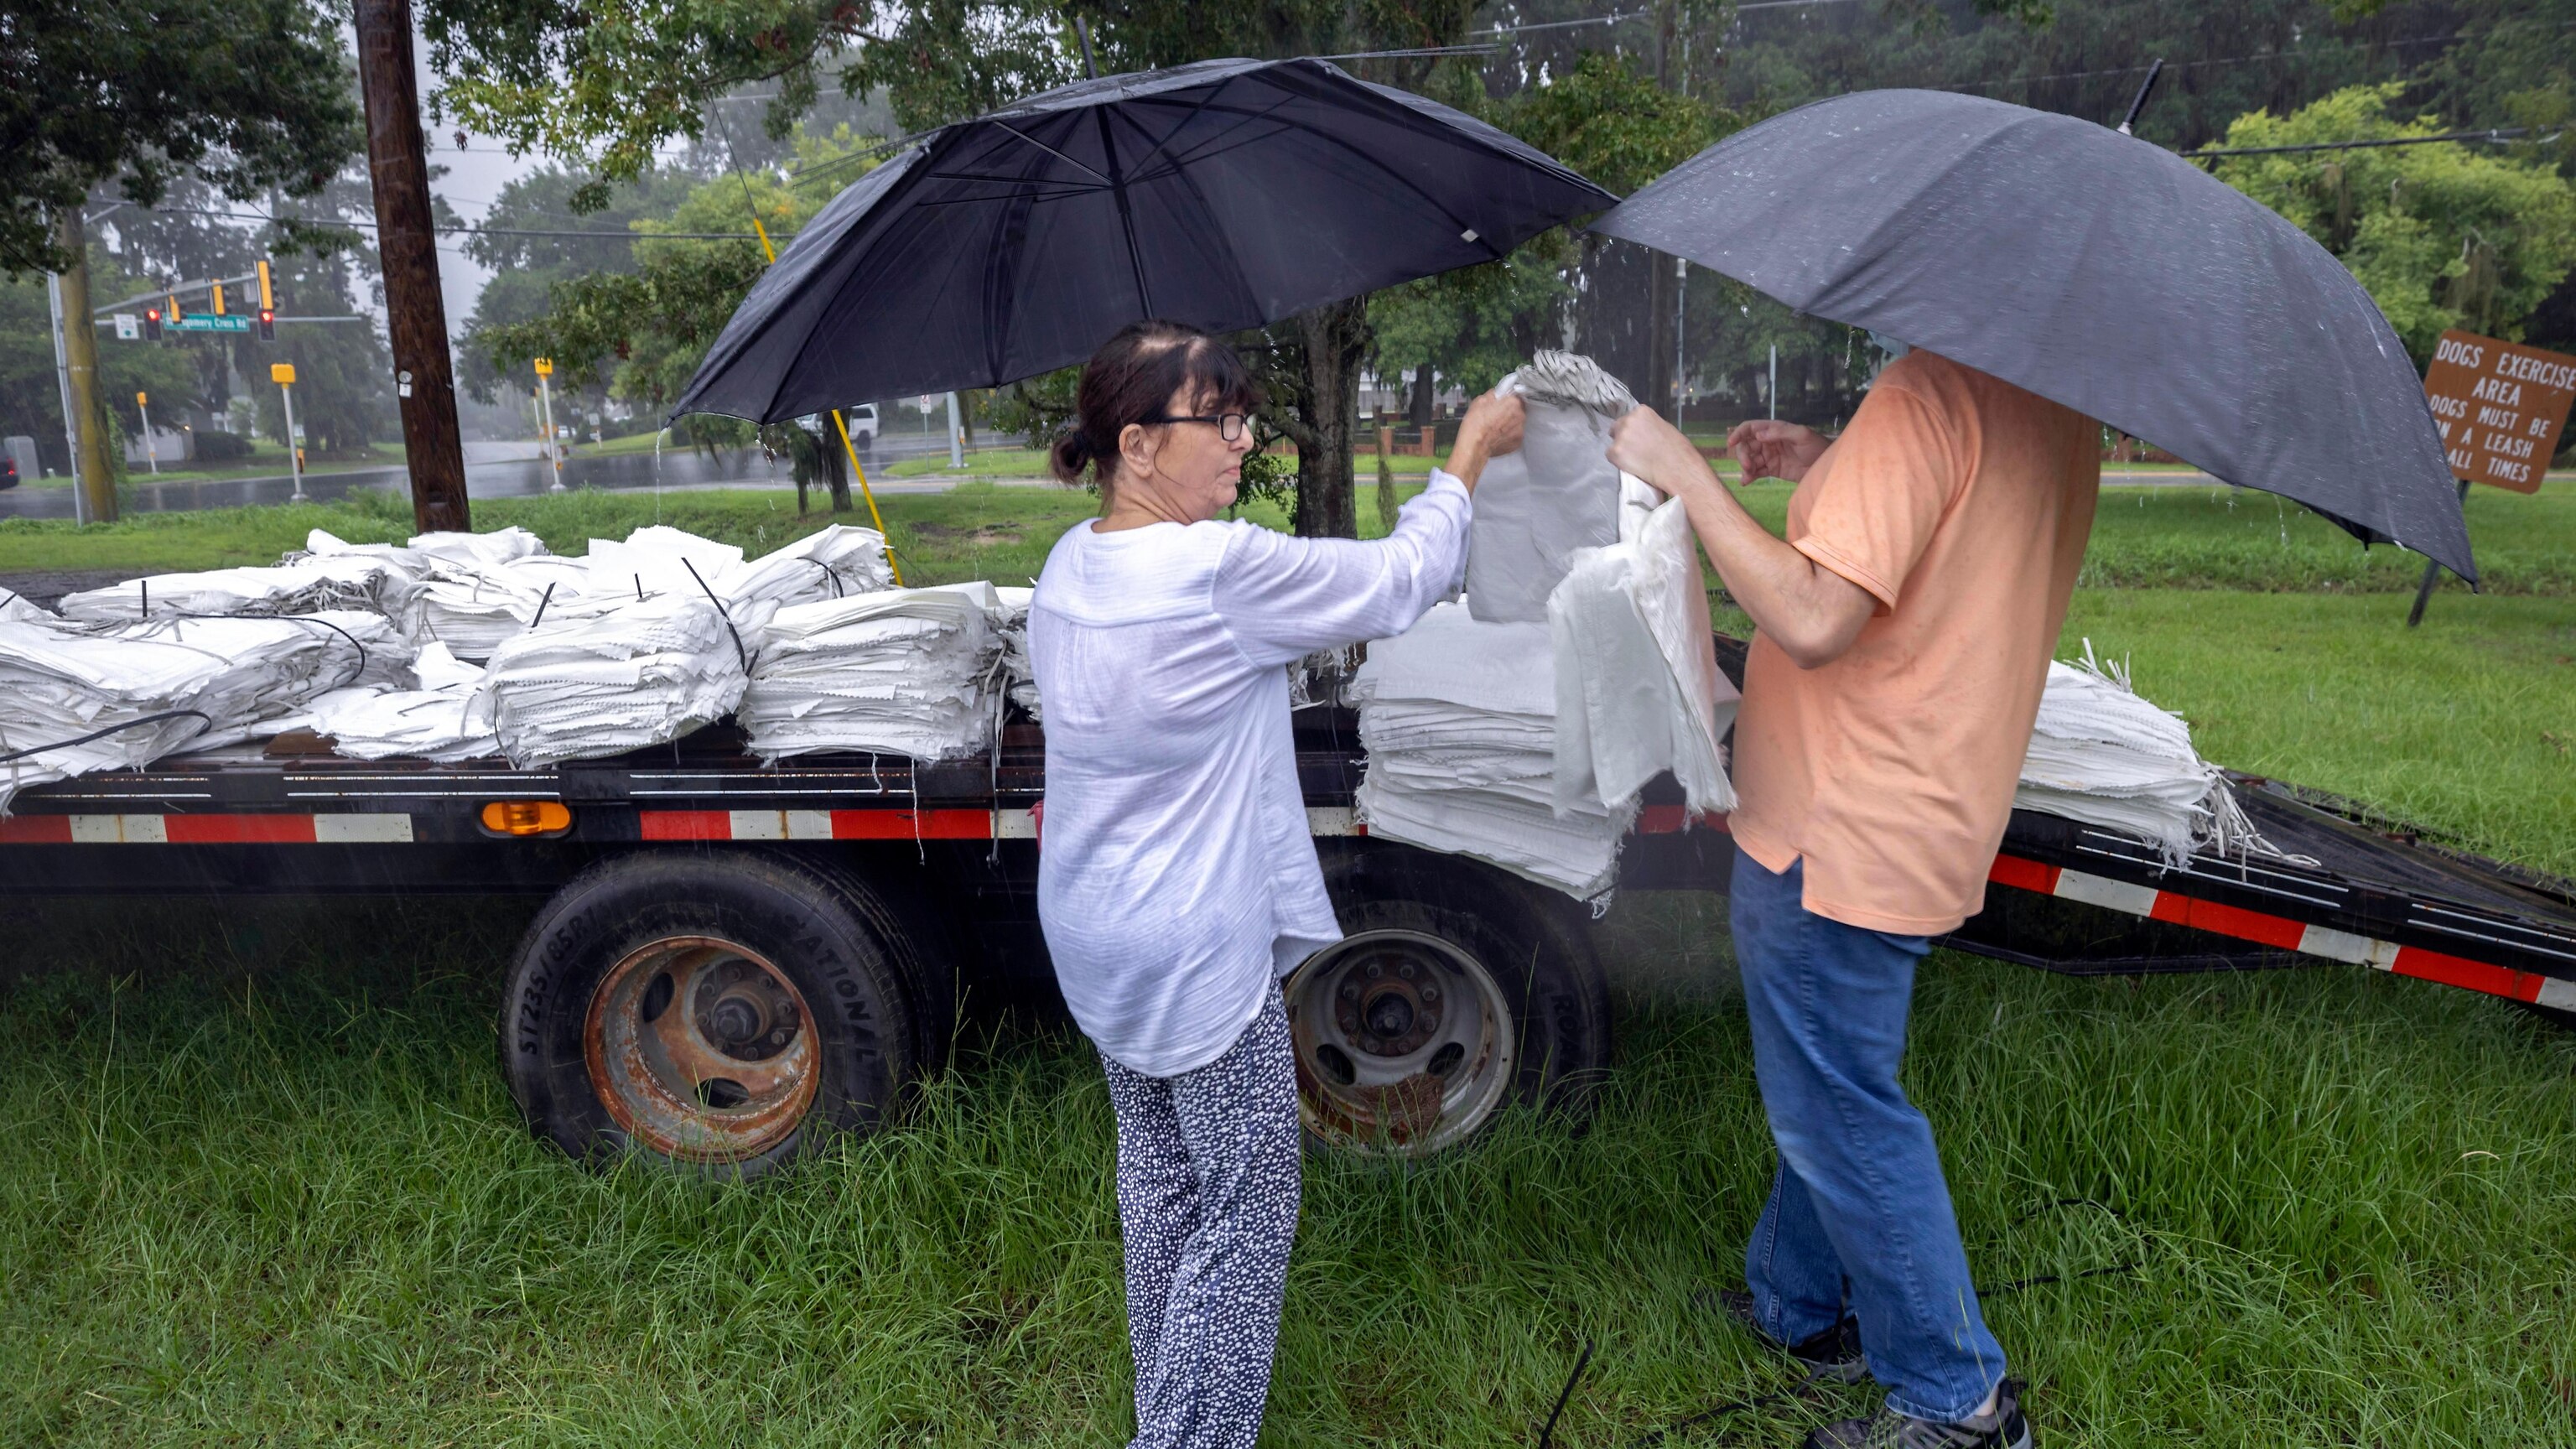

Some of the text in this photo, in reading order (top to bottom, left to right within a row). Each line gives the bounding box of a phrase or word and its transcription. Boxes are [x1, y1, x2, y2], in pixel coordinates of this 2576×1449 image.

[236, 319, 246, 329] Rd
[2436, 339, 2576, 392] DOGS EXERCISE
[2471, 377, 2521, 407] AREA
[2429, 394, 2551, 439] DOGS MUST BE
[2461, 428, 2474, 445] A
[2484, 433, 2534, 459] LEASH
[2447, 449, 2532, 483] ALL TIMES
